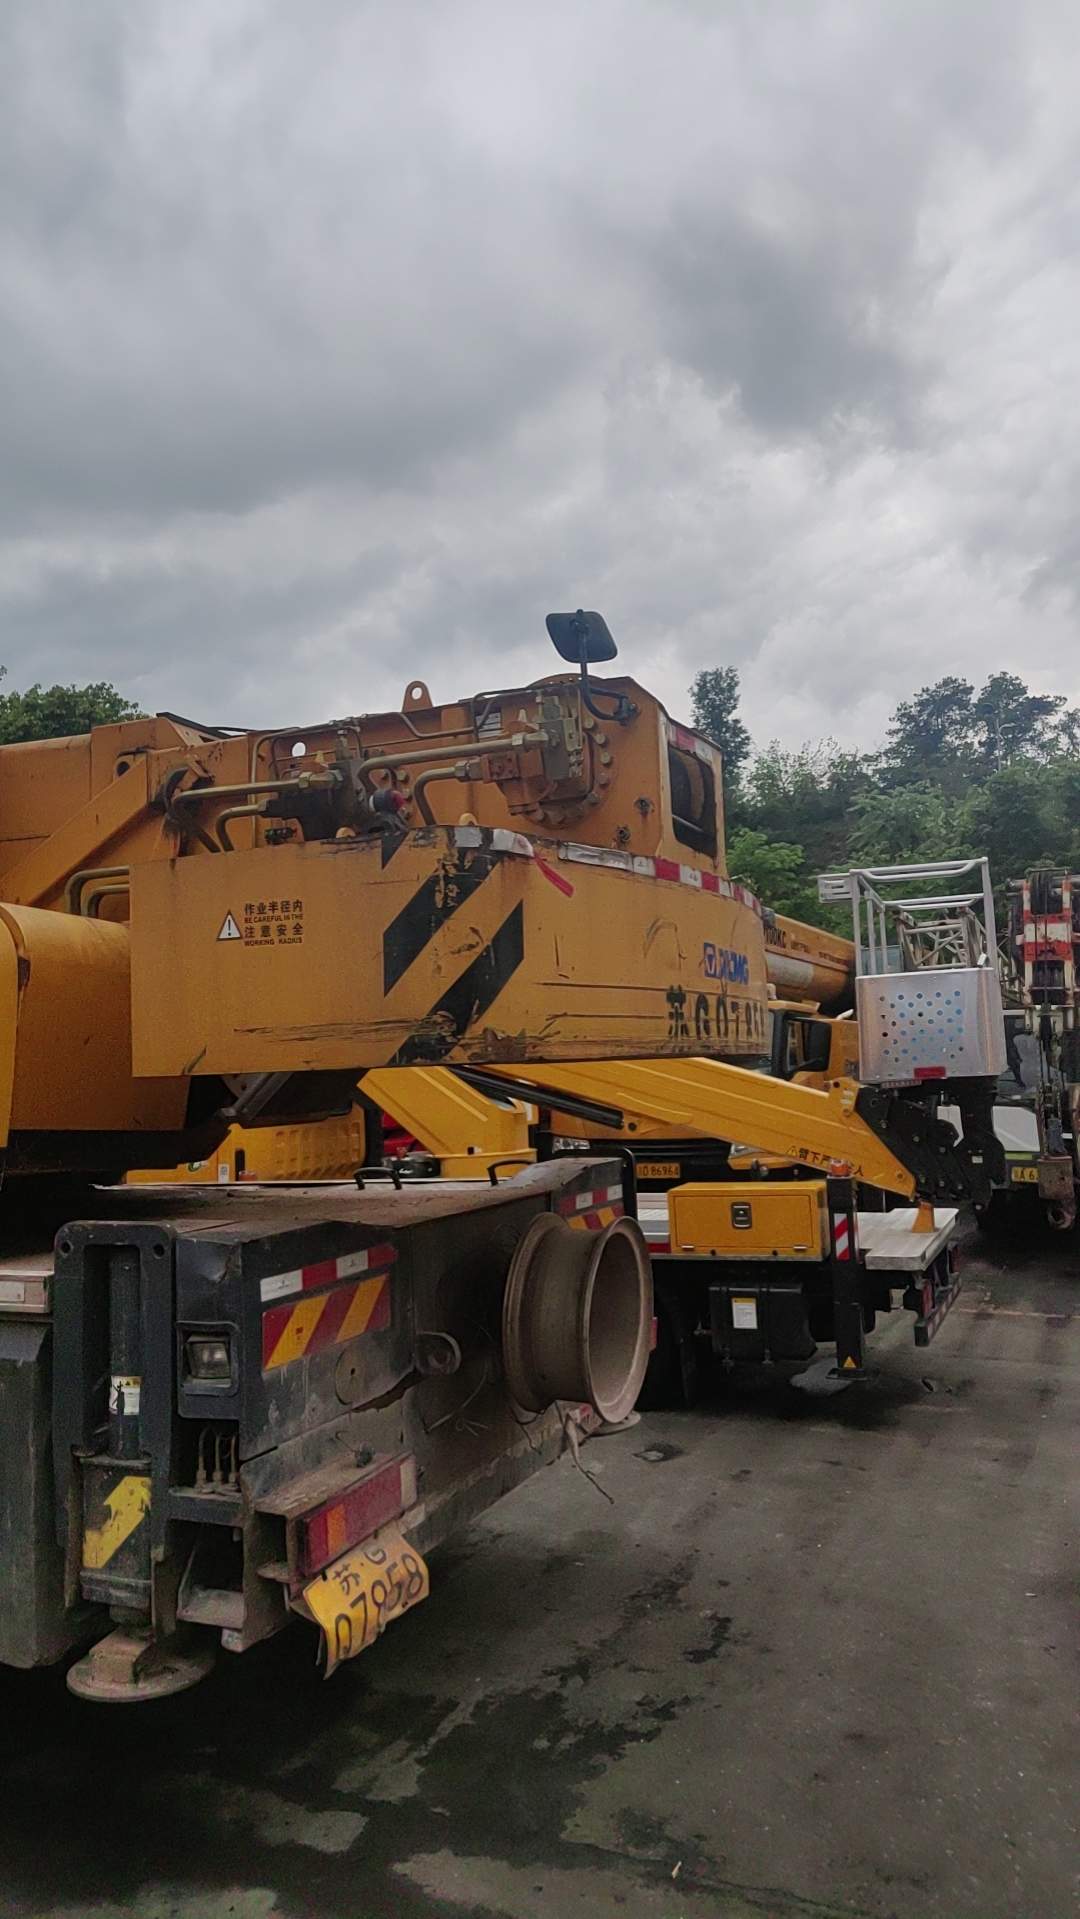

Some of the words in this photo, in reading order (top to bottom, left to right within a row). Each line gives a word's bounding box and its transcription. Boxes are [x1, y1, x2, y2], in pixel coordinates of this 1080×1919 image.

[244, 899, 303, 915] 作业半径内
[254, 915, 283, 923] CAREFUL
[244, 923, 304, 938] 注意安全
[244, 938, 275, 946] WORKING
